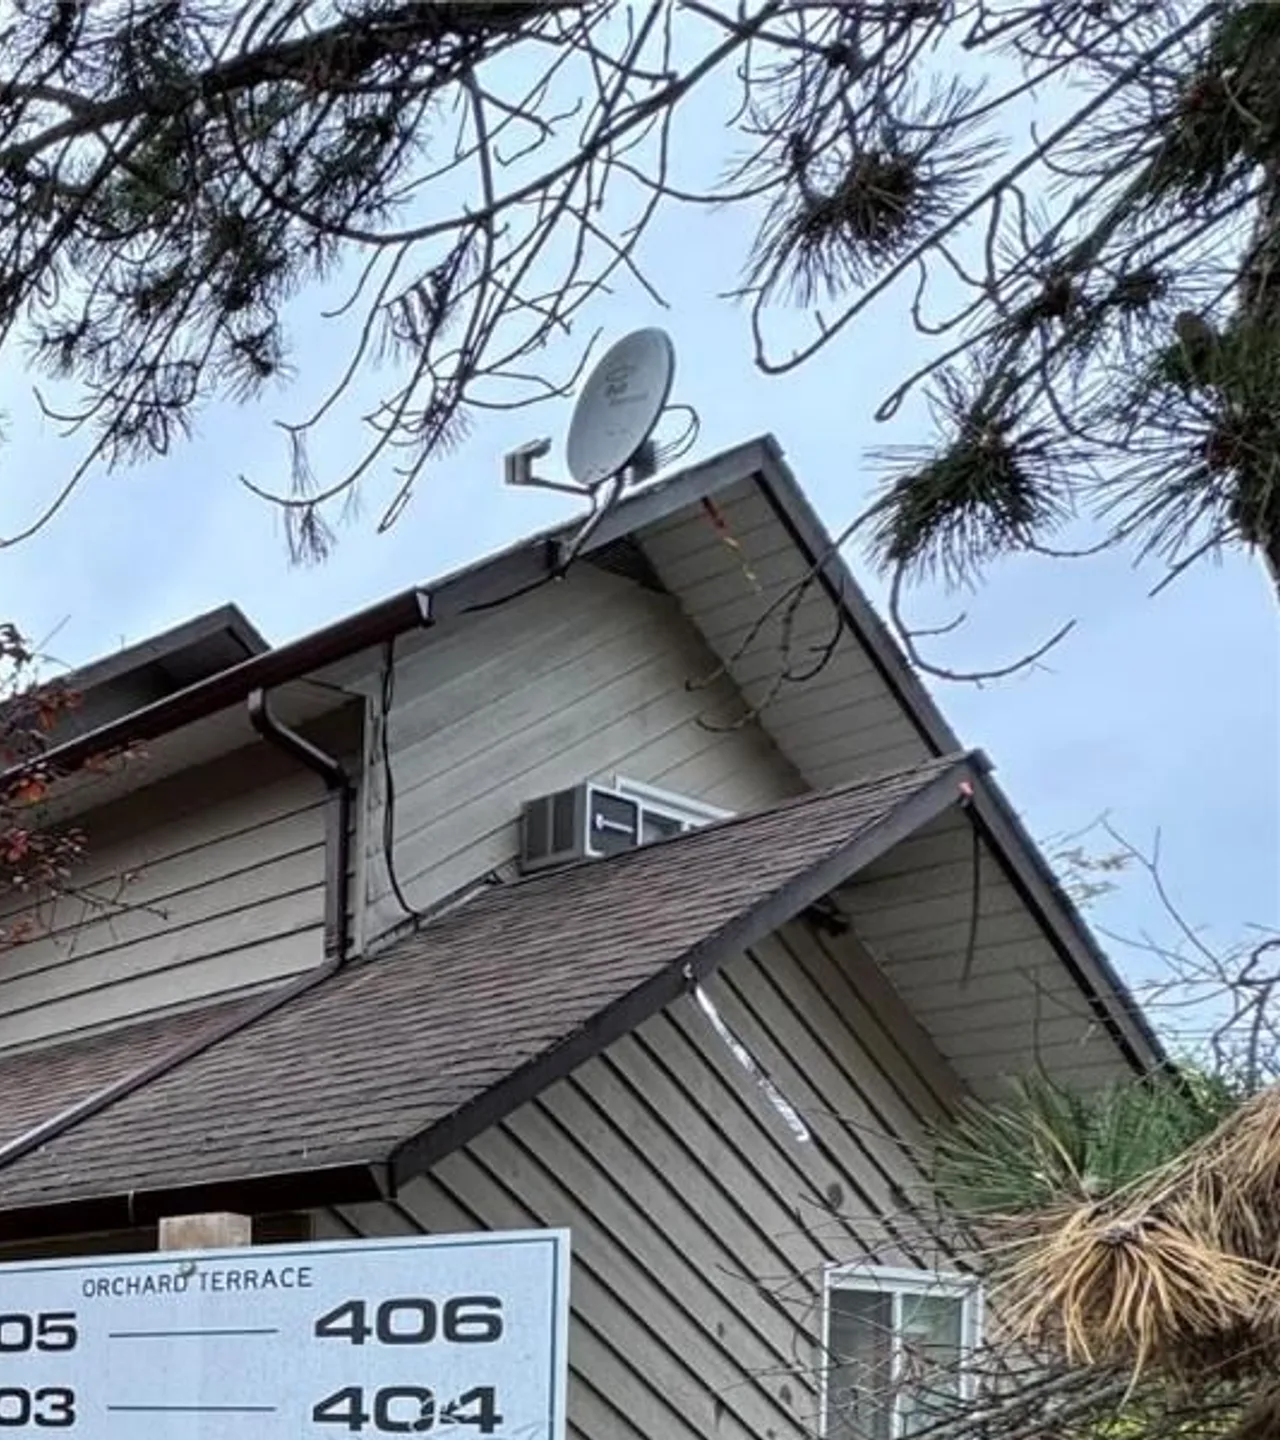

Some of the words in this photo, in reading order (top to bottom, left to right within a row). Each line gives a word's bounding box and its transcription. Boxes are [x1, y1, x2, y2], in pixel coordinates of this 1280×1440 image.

[82, 1274, 188, 1297] ORCHARD
[199, 1267, 313, 1291] TERRACE
[314, 1296, 504, 1345] 406
[313, 1386, 504, 1434] 404
